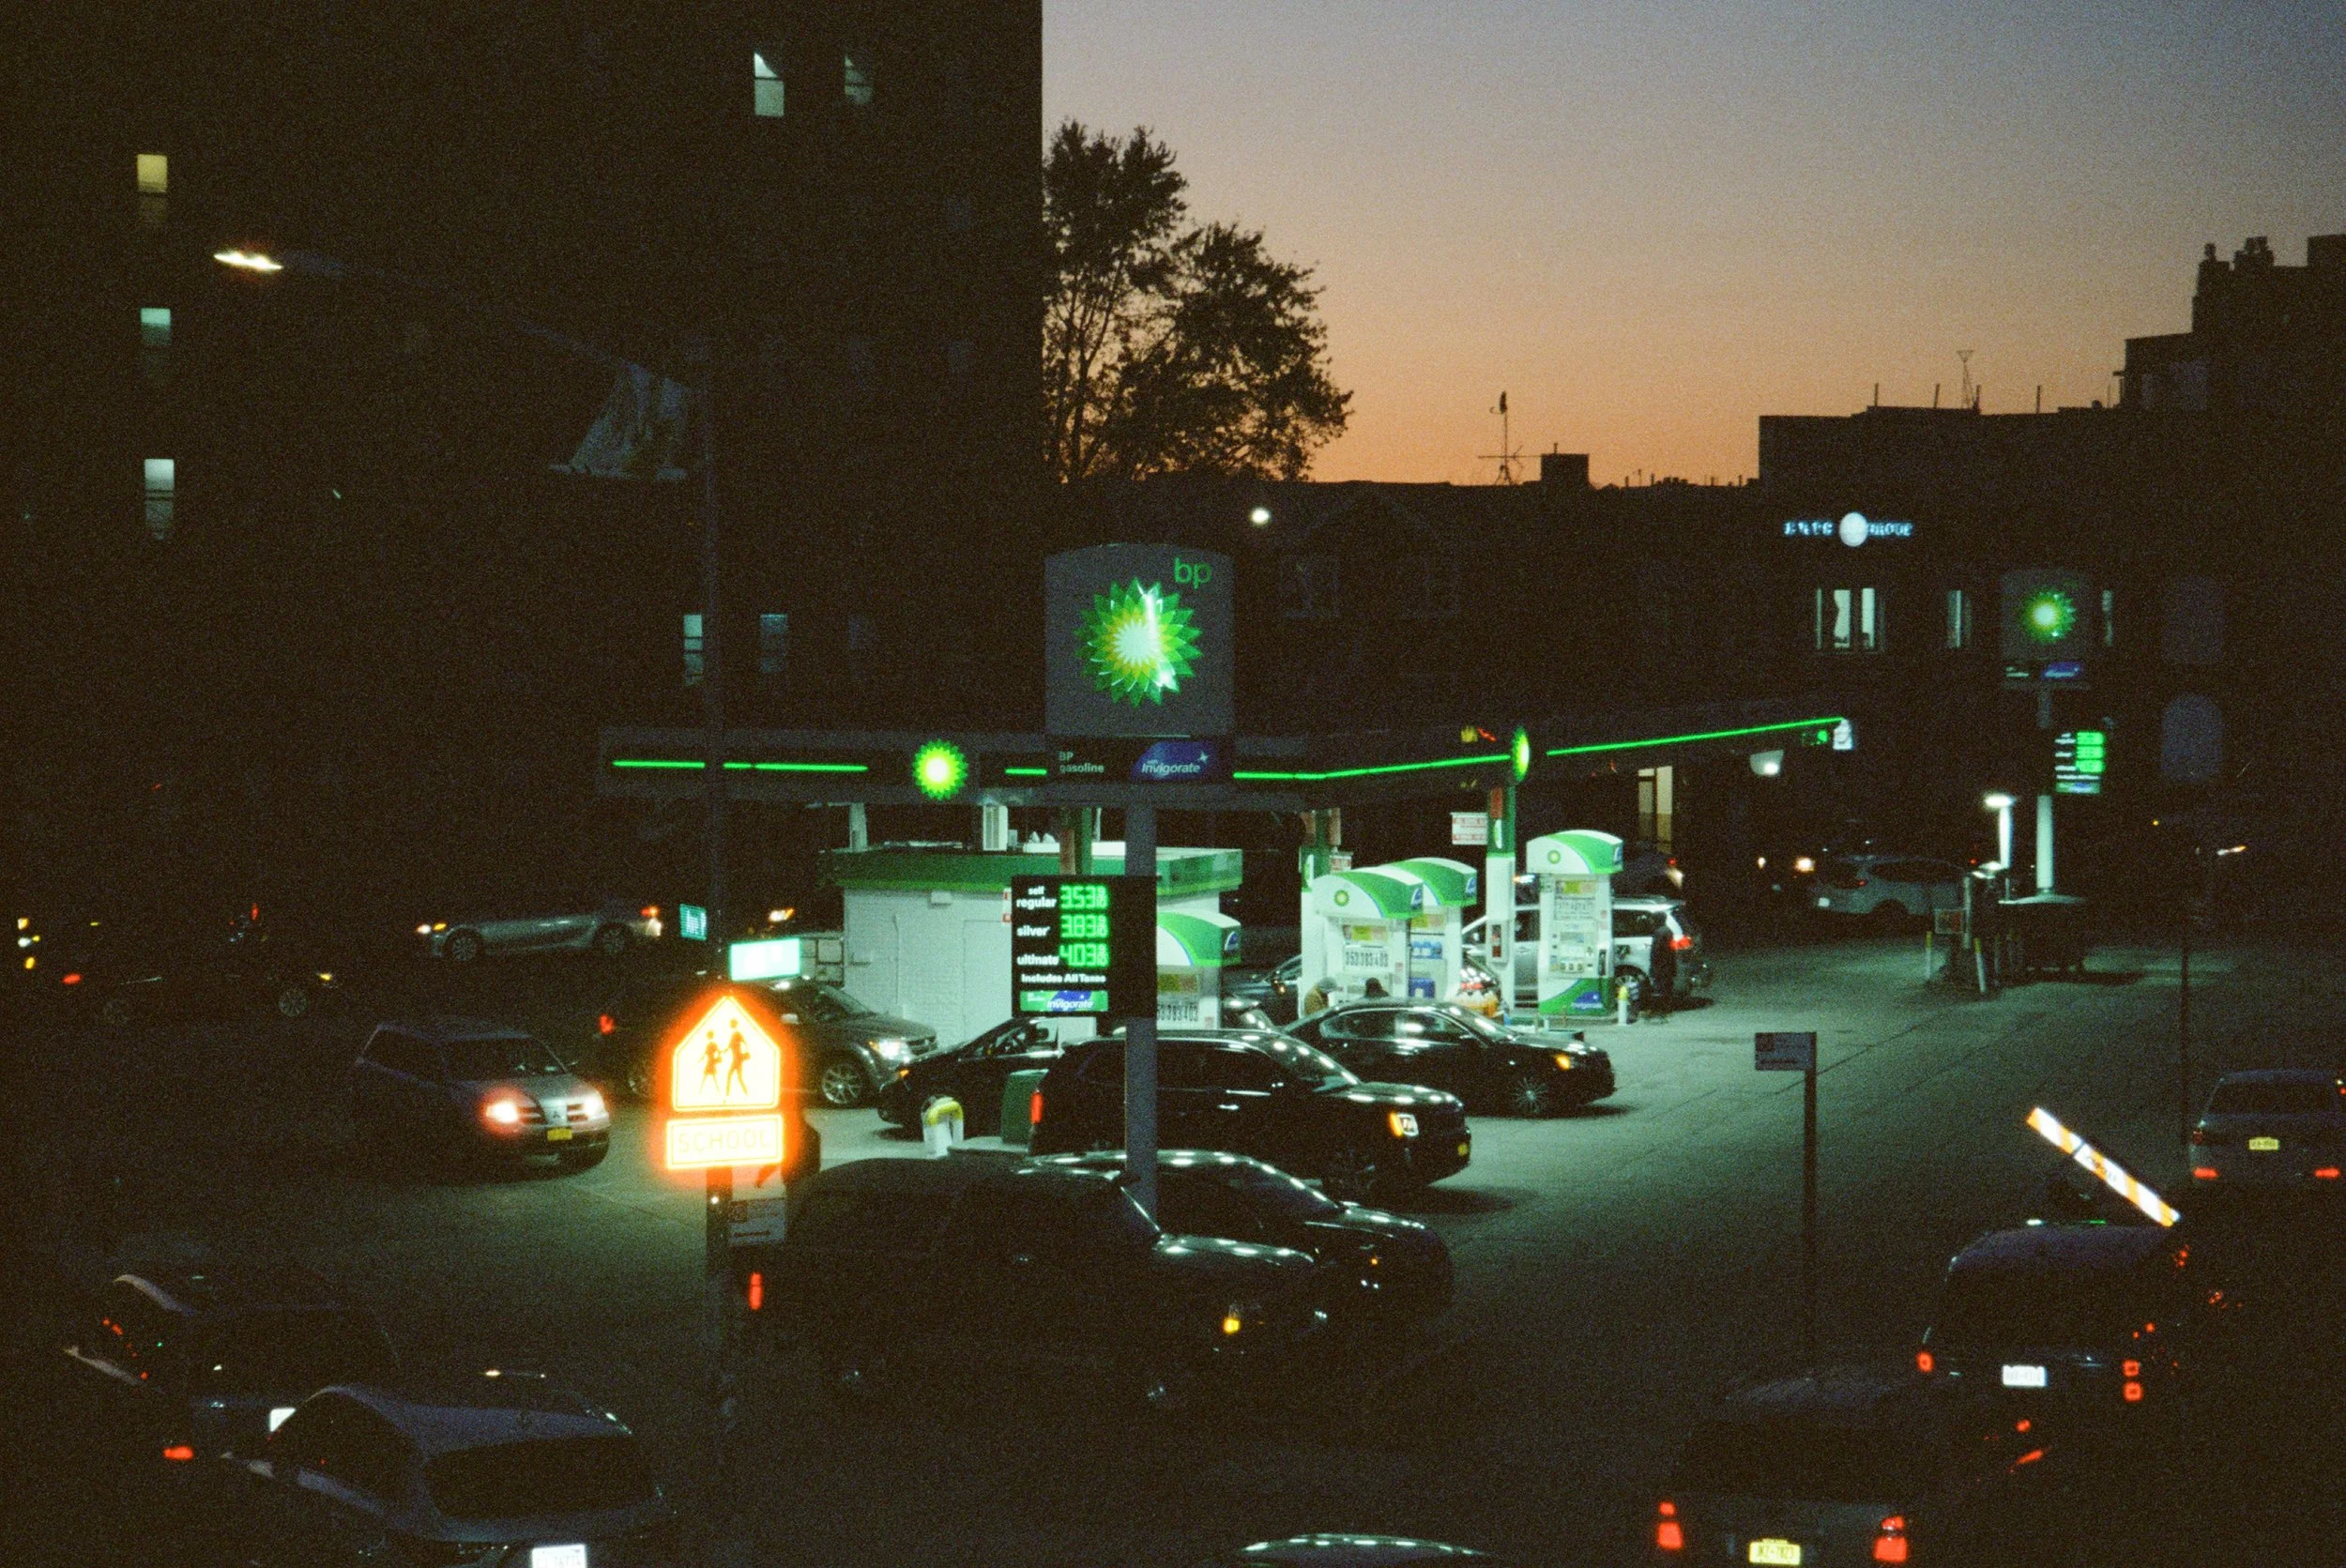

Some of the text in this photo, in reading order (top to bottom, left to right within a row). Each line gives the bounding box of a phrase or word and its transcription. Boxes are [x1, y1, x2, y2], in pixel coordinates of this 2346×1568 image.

[1174, 557, 1212, 589] bp
[1059, 762, 1104, 774] gasoline
[1016, 898, 1056, 910] regular
[1016, 955, 1059, 966] ultimate
[1021, 973, 1106, 982] Includes All Taxes
[678, 1129, 770, 1153] SCHOOL
